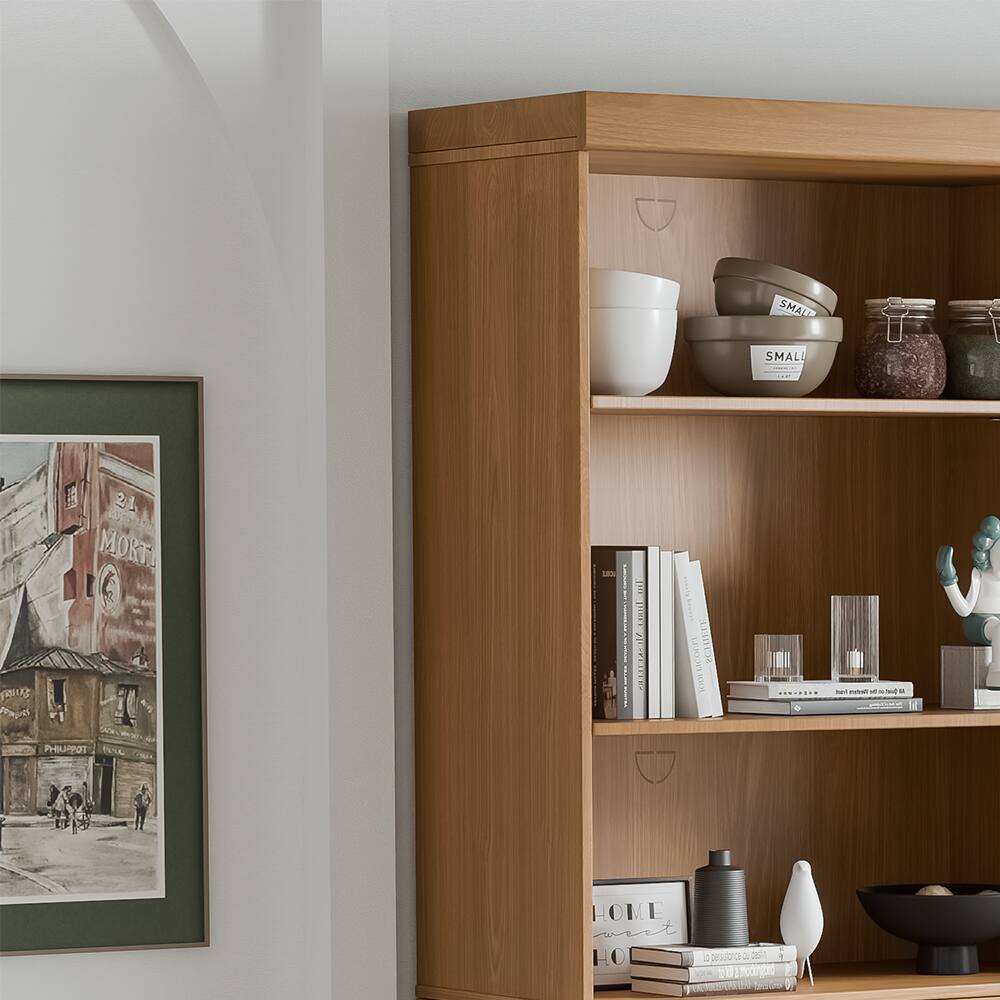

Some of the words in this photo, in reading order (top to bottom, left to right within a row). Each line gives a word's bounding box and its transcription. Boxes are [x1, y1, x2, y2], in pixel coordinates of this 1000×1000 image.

[116, 492, 137, 512] 21
[593, 902, 664, 922] HOME
[593, 920, 677, 938] weet
[593, 947, 627, 967] HO
